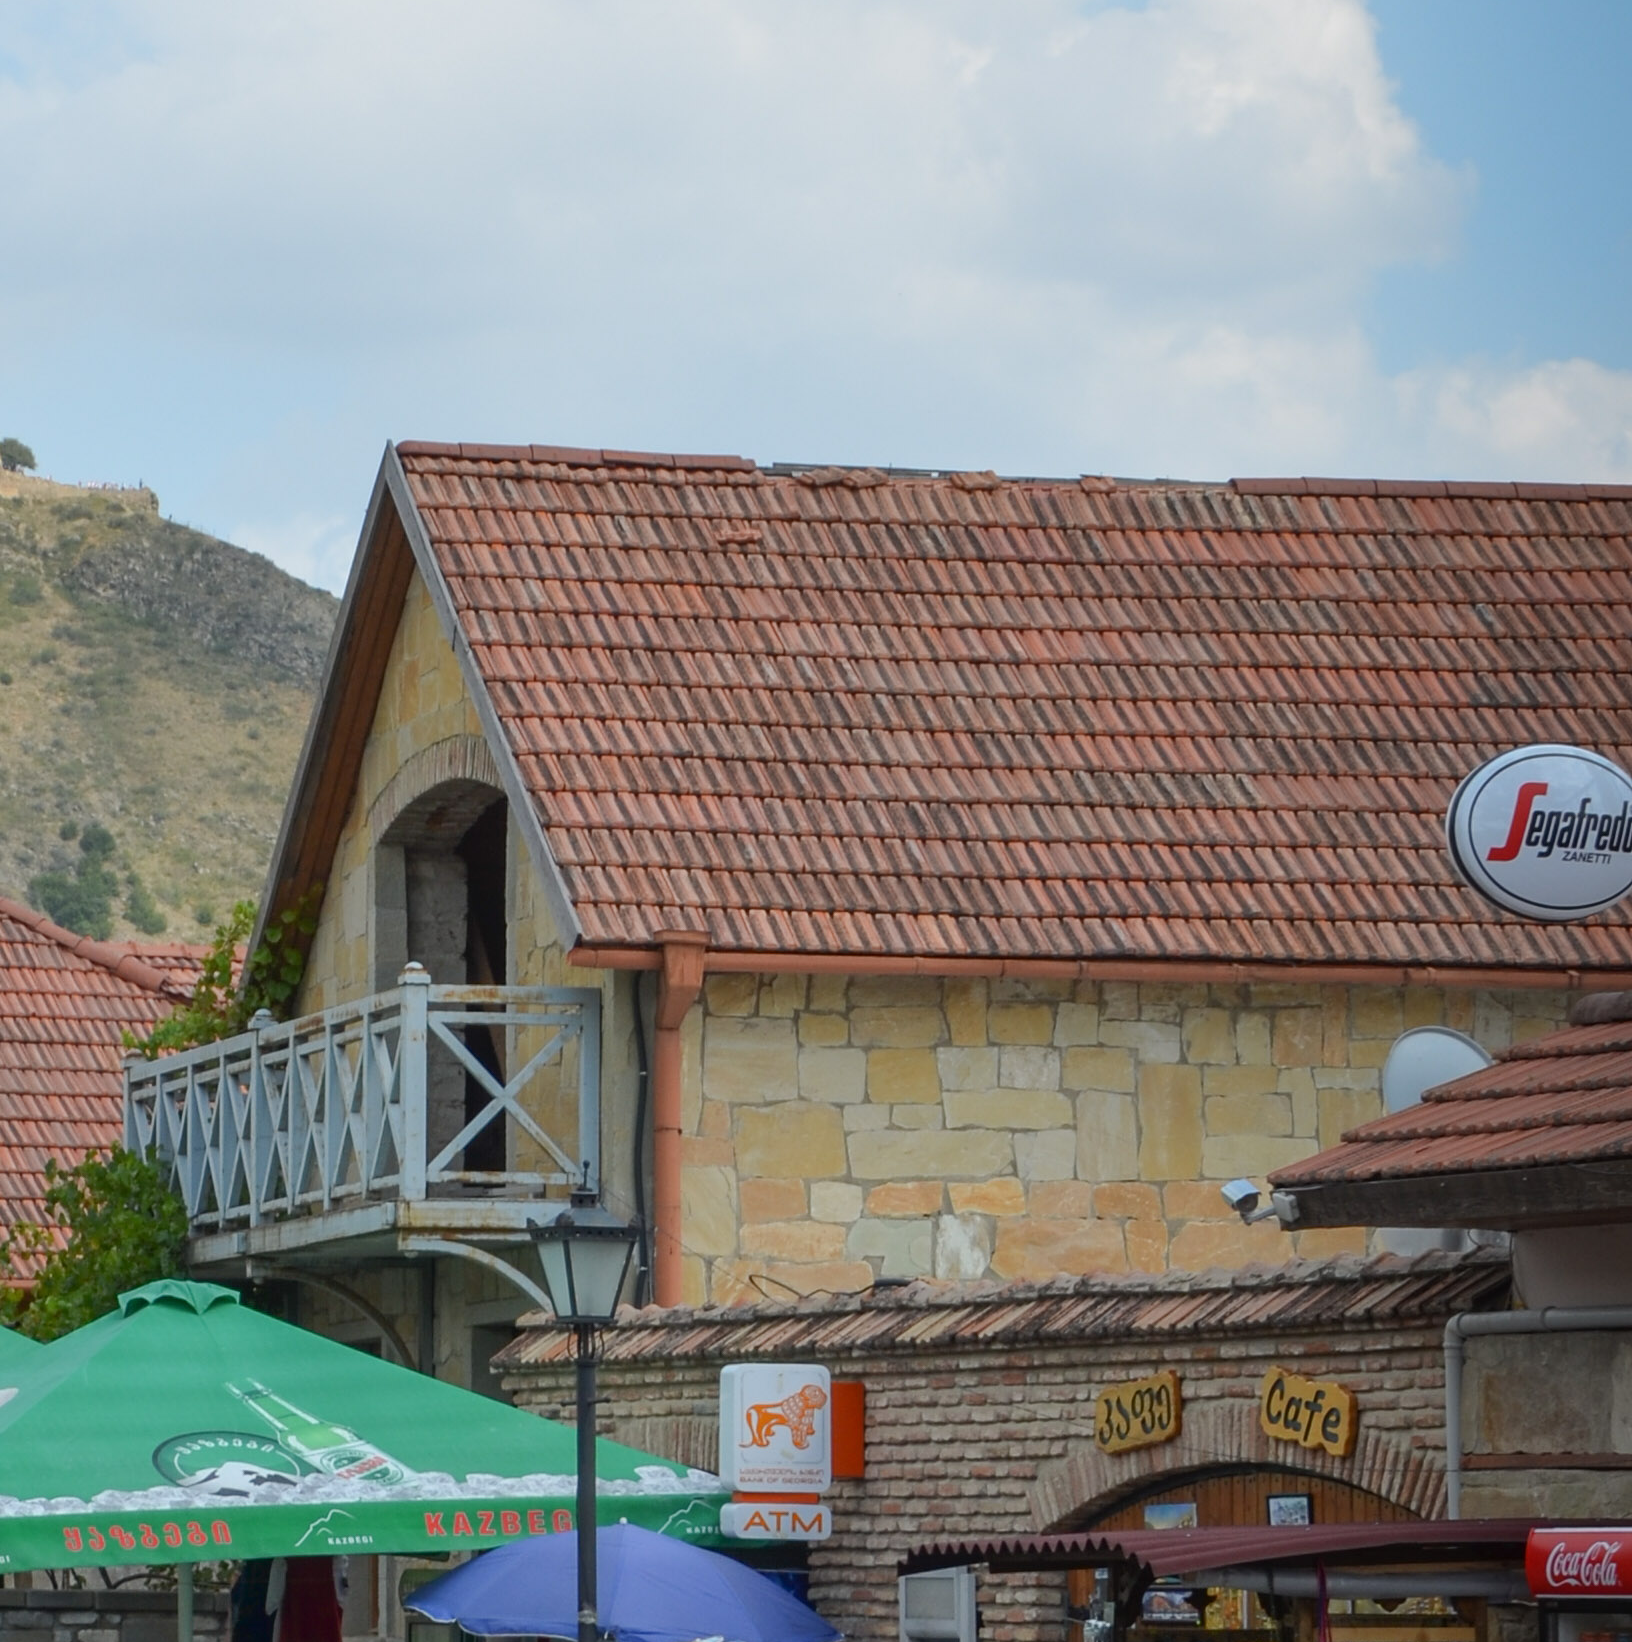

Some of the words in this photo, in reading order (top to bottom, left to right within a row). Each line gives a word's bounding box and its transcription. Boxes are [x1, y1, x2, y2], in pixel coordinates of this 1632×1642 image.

[1562, 851, 1611, 865] ZANETTI
[1099, 1384, 1172, 1445] კაფე
[1266, 1377, 1341, 1444] Cafe
[424, 1508, 573, 1537] KAZBEG
[743, 1510, 824, 1533] ATM
